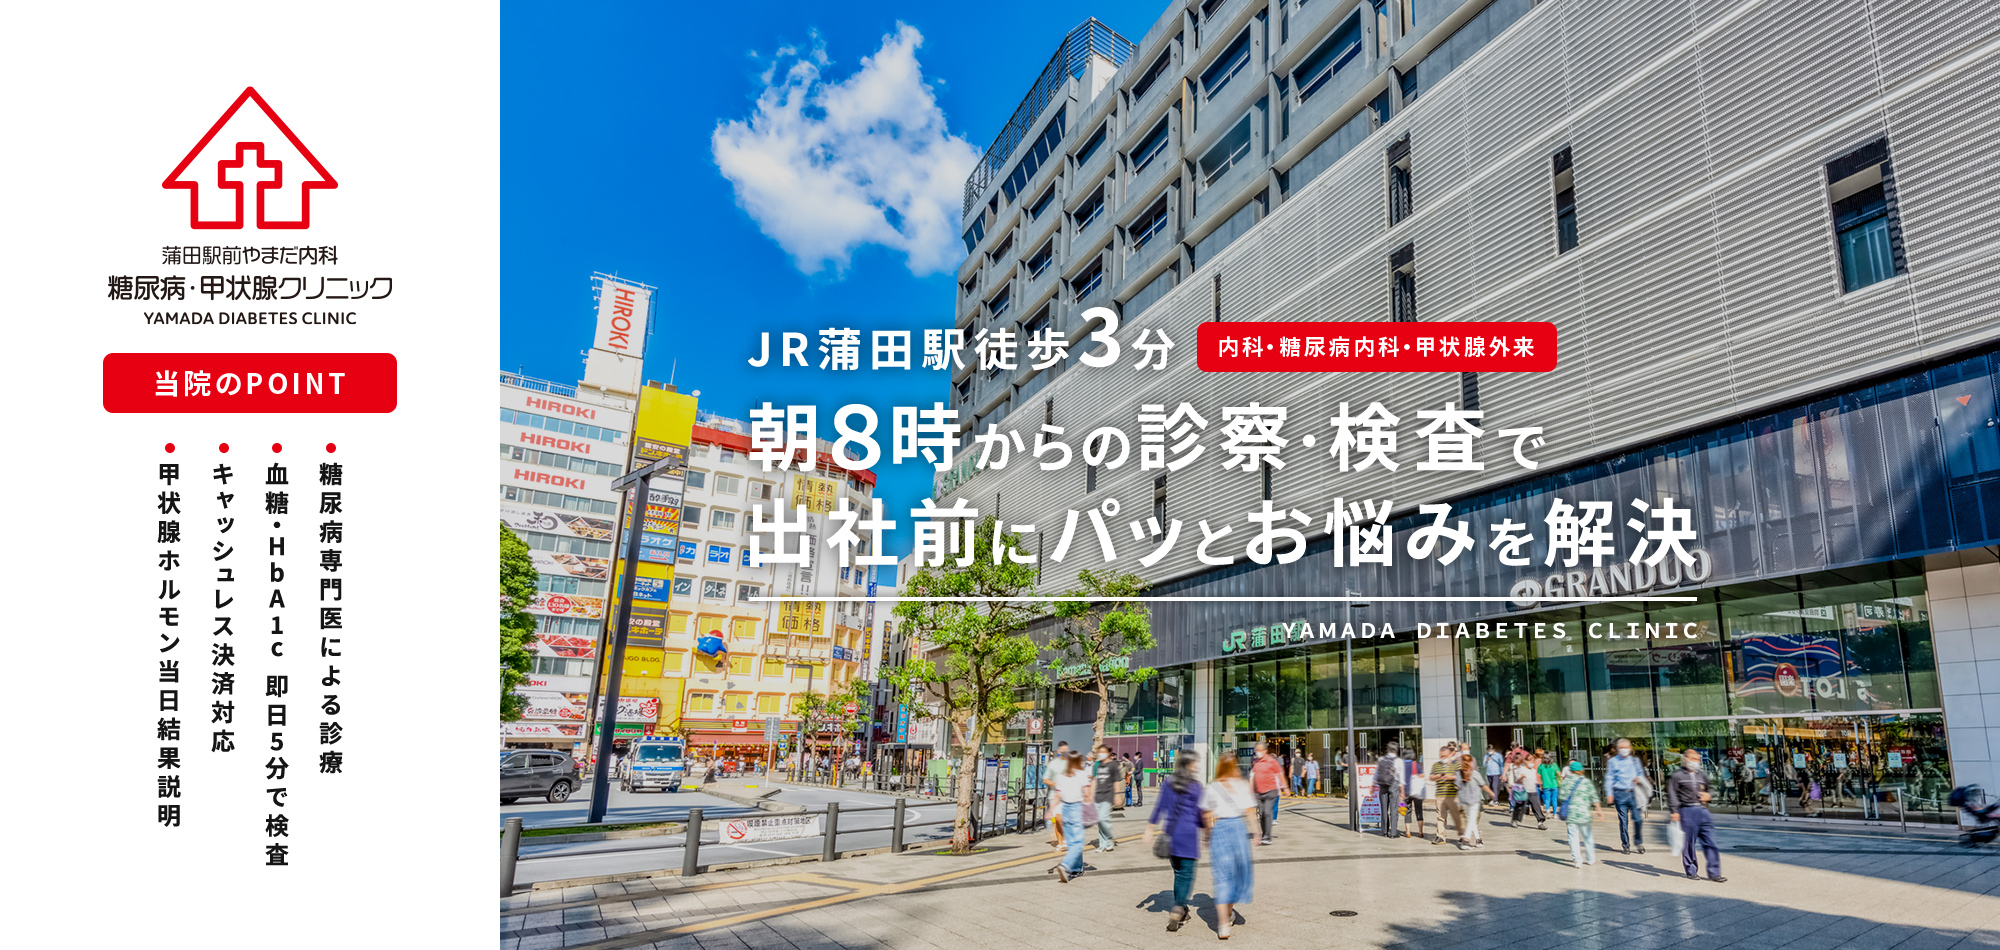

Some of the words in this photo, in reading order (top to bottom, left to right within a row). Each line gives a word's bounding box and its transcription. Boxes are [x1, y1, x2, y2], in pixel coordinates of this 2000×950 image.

[607, 287, 636, 350] HIROKI
[526, 396, 595, 421] HIROKI
[520, 431, 591, 455] HIROKI
[514, 468, 586, 490] HIROKI
[641, 535, 673, 546] ラオケ
